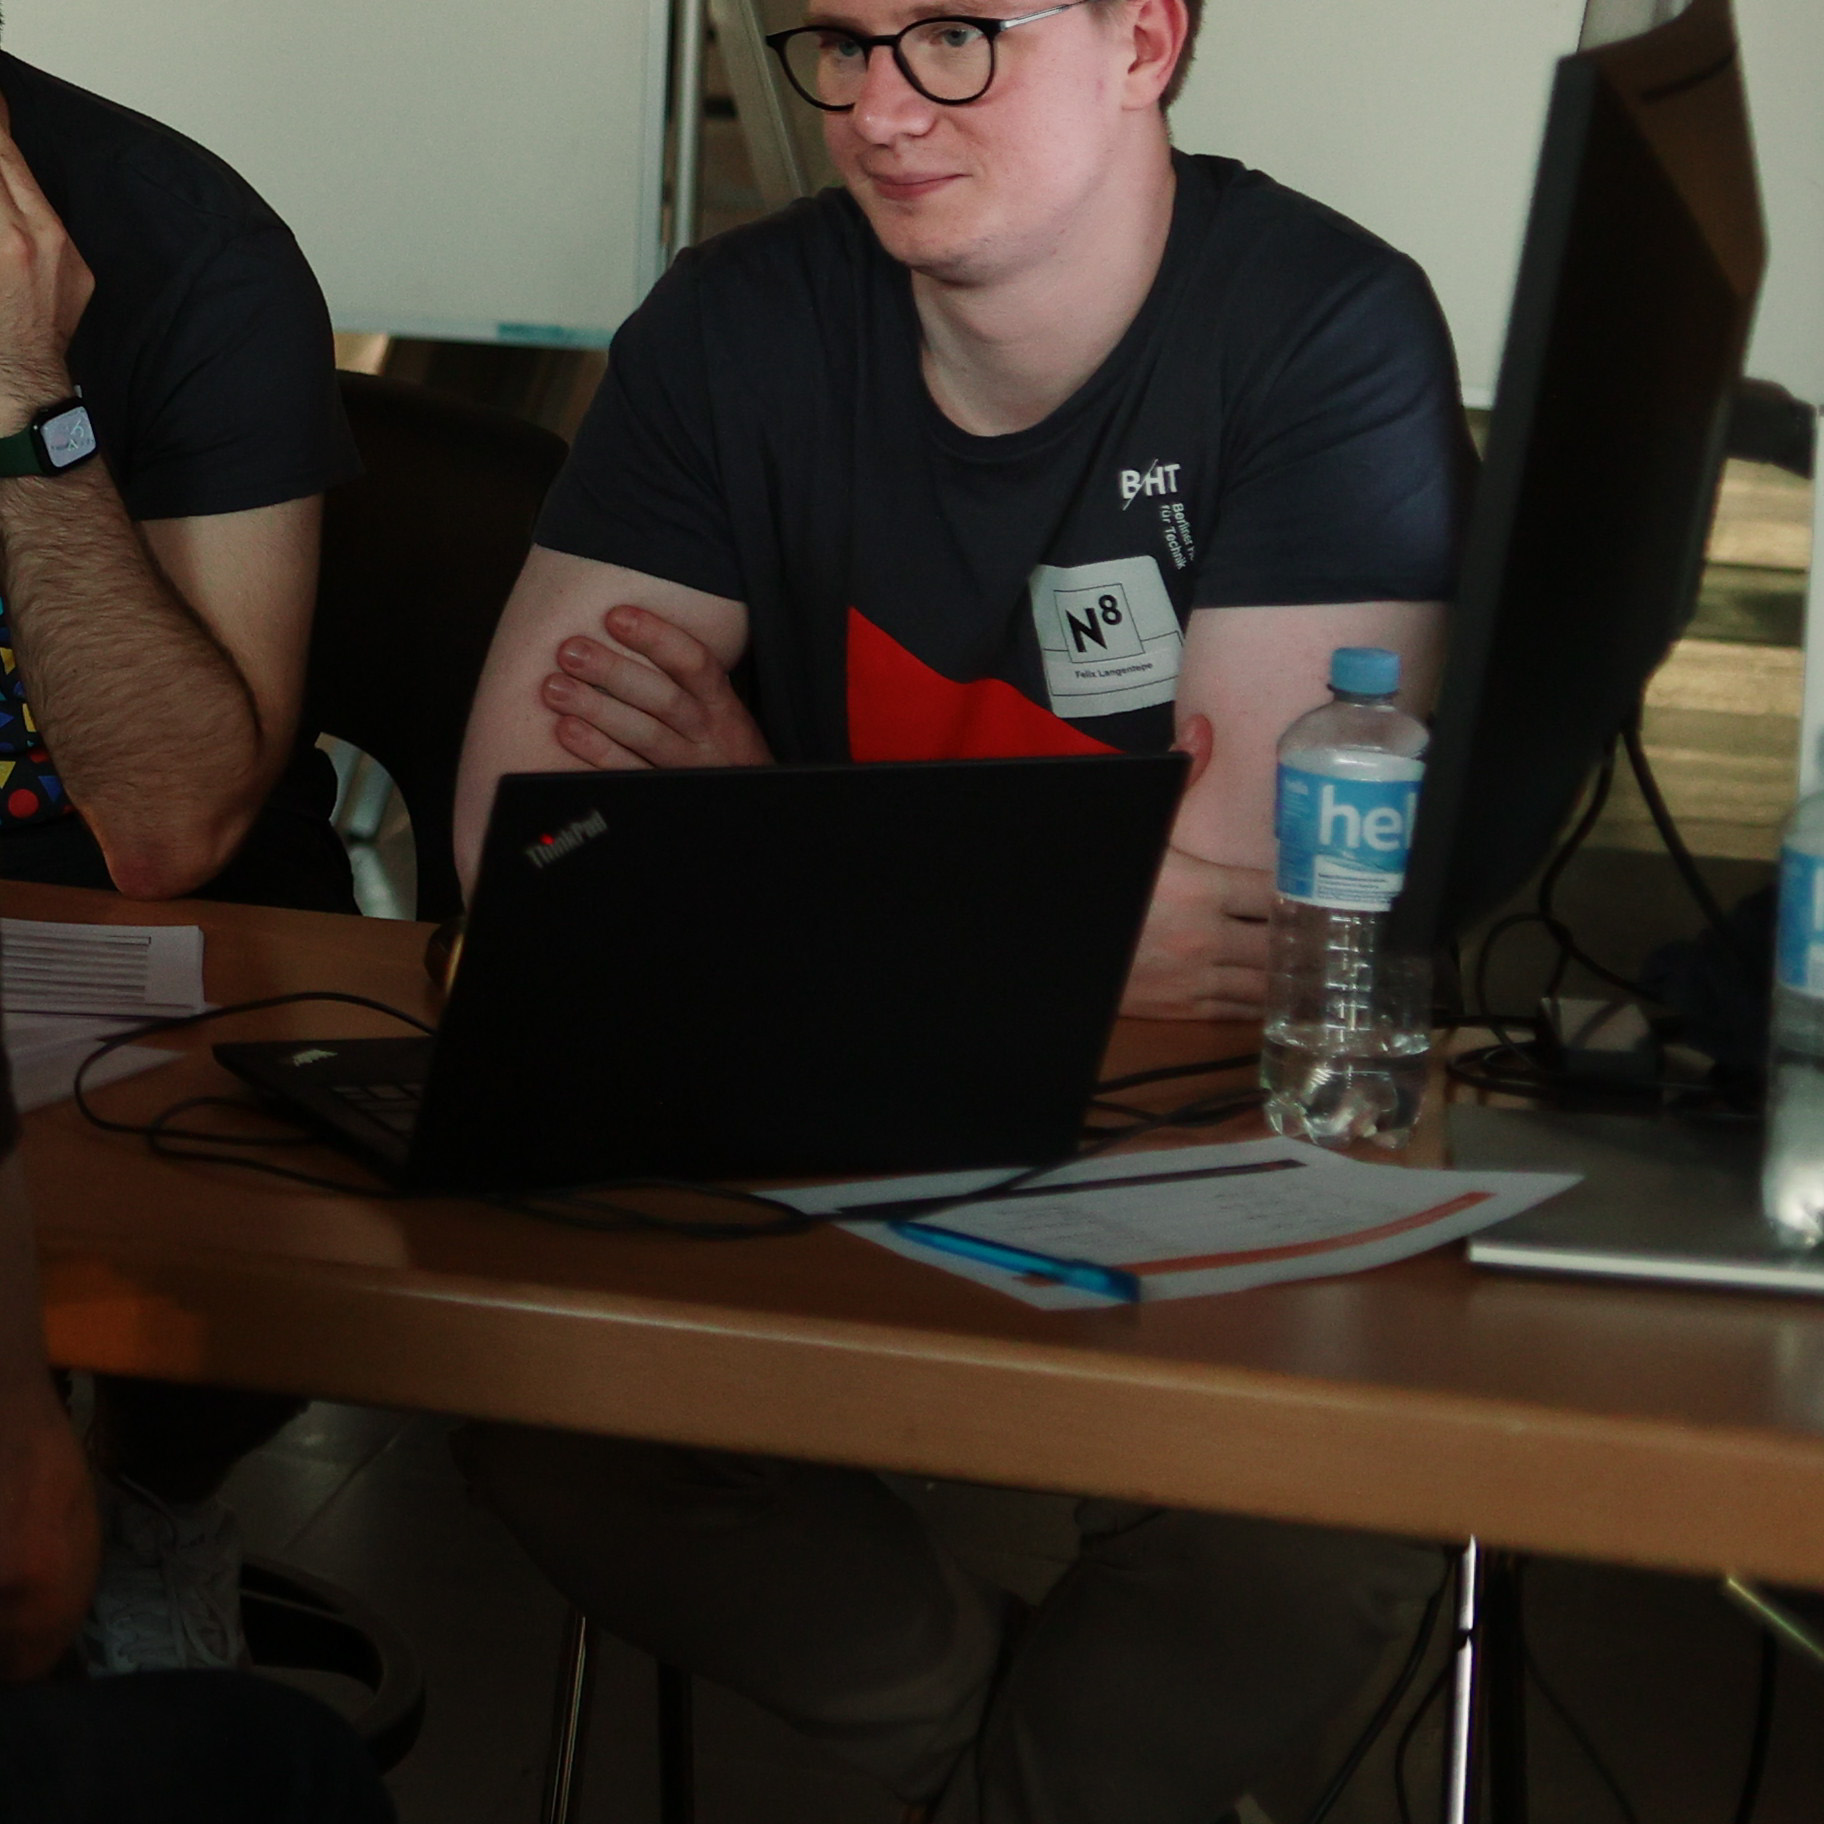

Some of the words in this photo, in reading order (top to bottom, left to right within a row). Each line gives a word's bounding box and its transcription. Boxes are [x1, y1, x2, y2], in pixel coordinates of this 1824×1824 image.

[1120, 463, 1182, 500] BHT
[1164, 525, 1188, 571] Technik
[1075, 669, 1098, 680] Felix
[523, 808, 609, 870] ThinkPad
